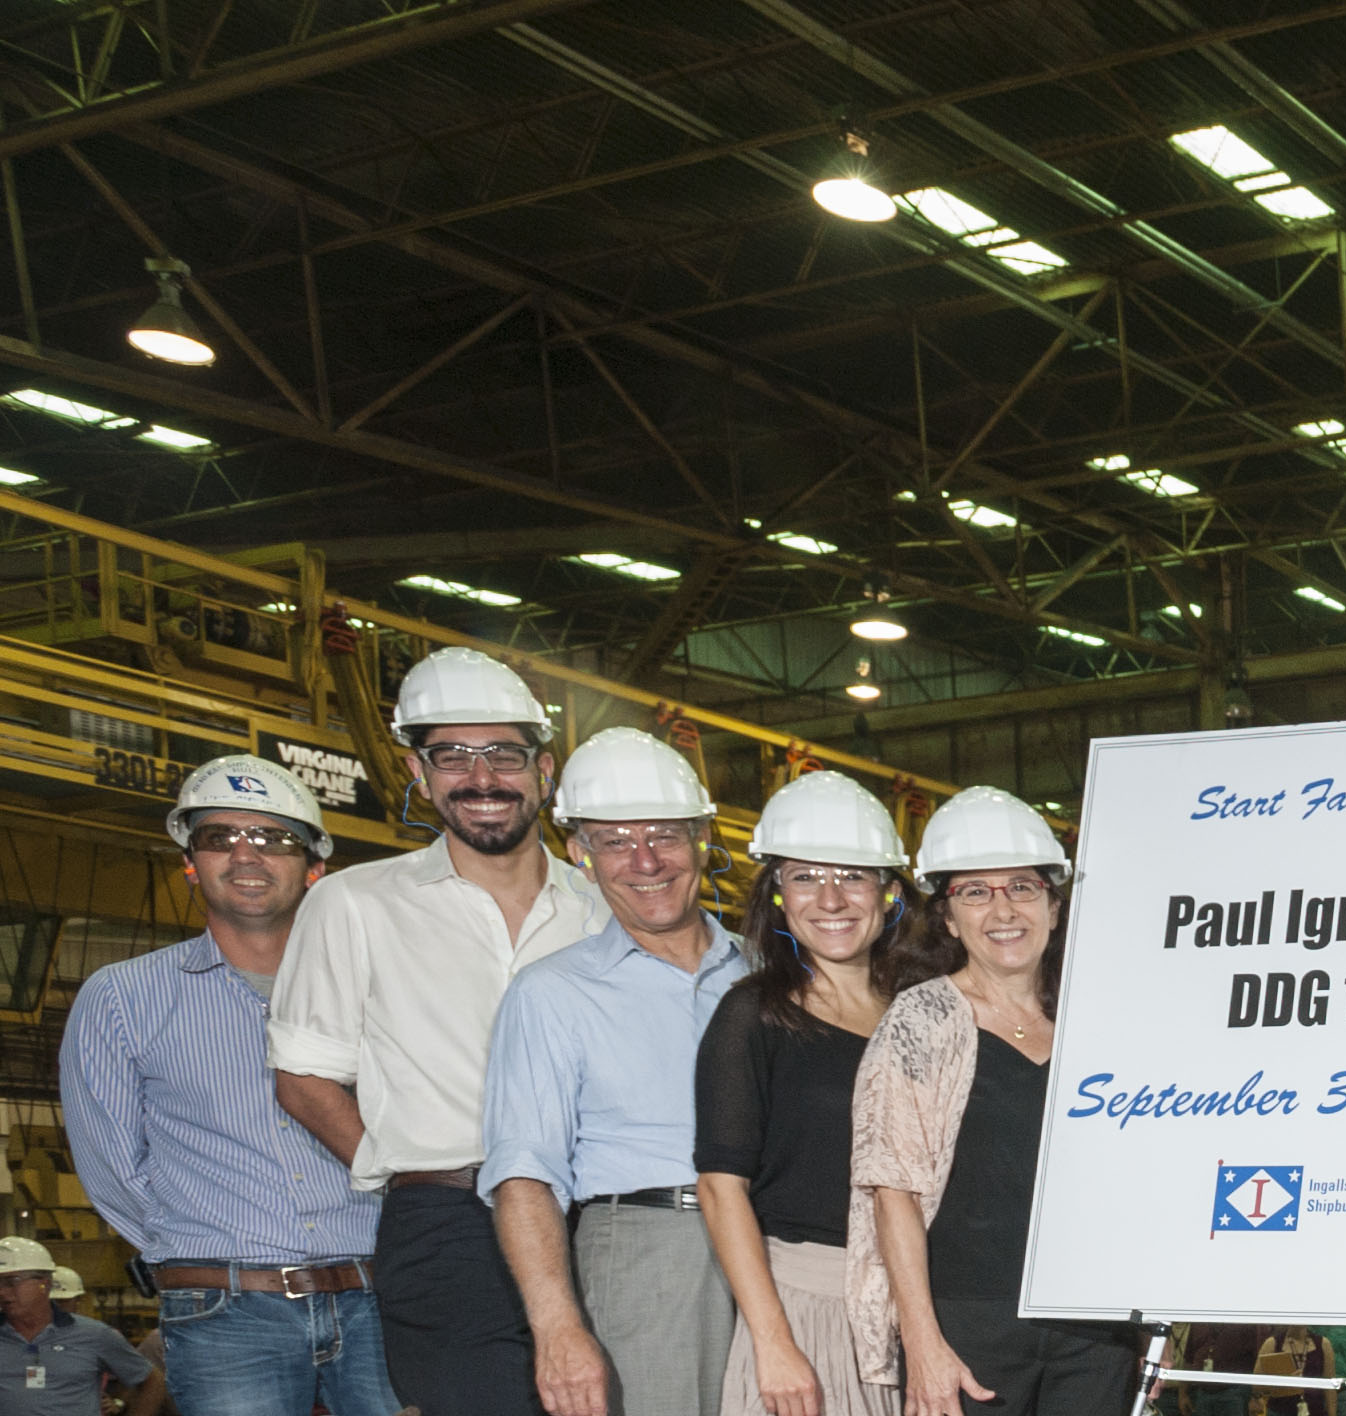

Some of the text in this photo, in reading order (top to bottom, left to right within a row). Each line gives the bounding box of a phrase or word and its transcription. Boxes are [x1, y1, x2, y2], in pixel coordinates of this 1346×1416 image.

[278, 742, 369, 781] VIRGINIA
[290, 765, 356, 793] CRANE
[1190, 784, 1287, 821] Start
[1163, 890, 1275, 949] Paul
[1227, 970, 1331, 1028] DDG
[1067, 1070, 1300, 1130] September
